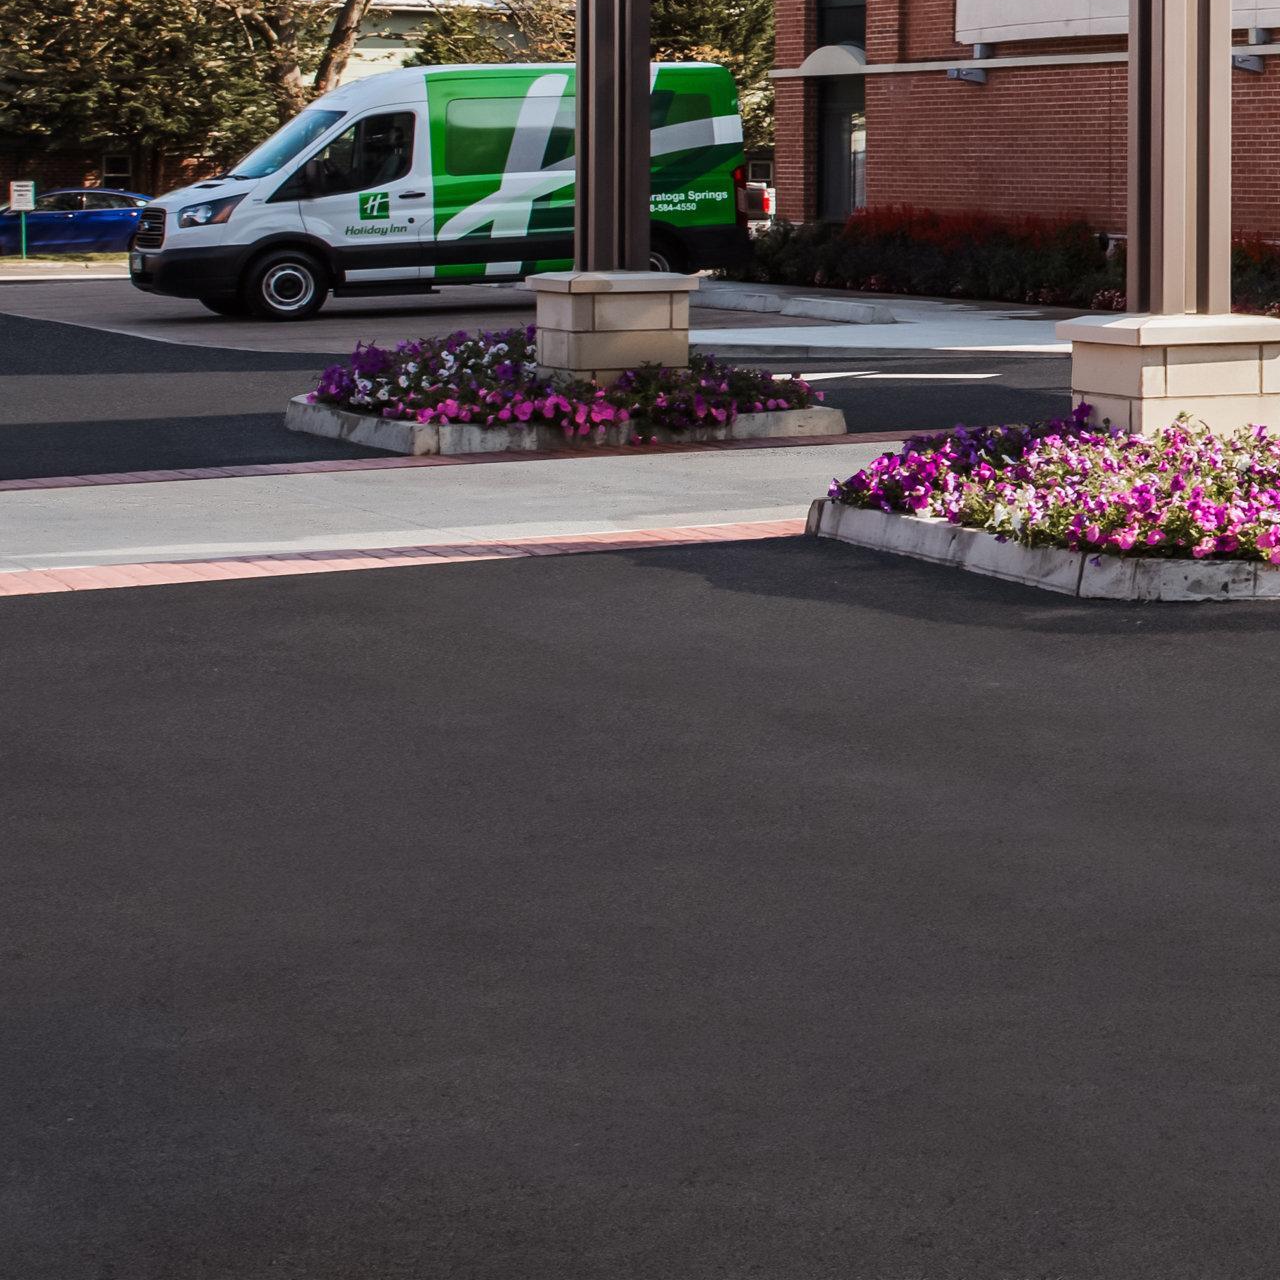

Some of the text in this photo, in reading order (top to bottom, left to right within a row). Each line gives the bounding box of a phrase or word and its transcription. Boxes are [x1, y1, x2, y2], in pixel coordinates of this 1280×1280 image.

[650, 190, 728, 203] ratoga Springs
[650, 203, 697, 212] 8-584-4550
[345, 224, 408, 236] Holiday Inn
